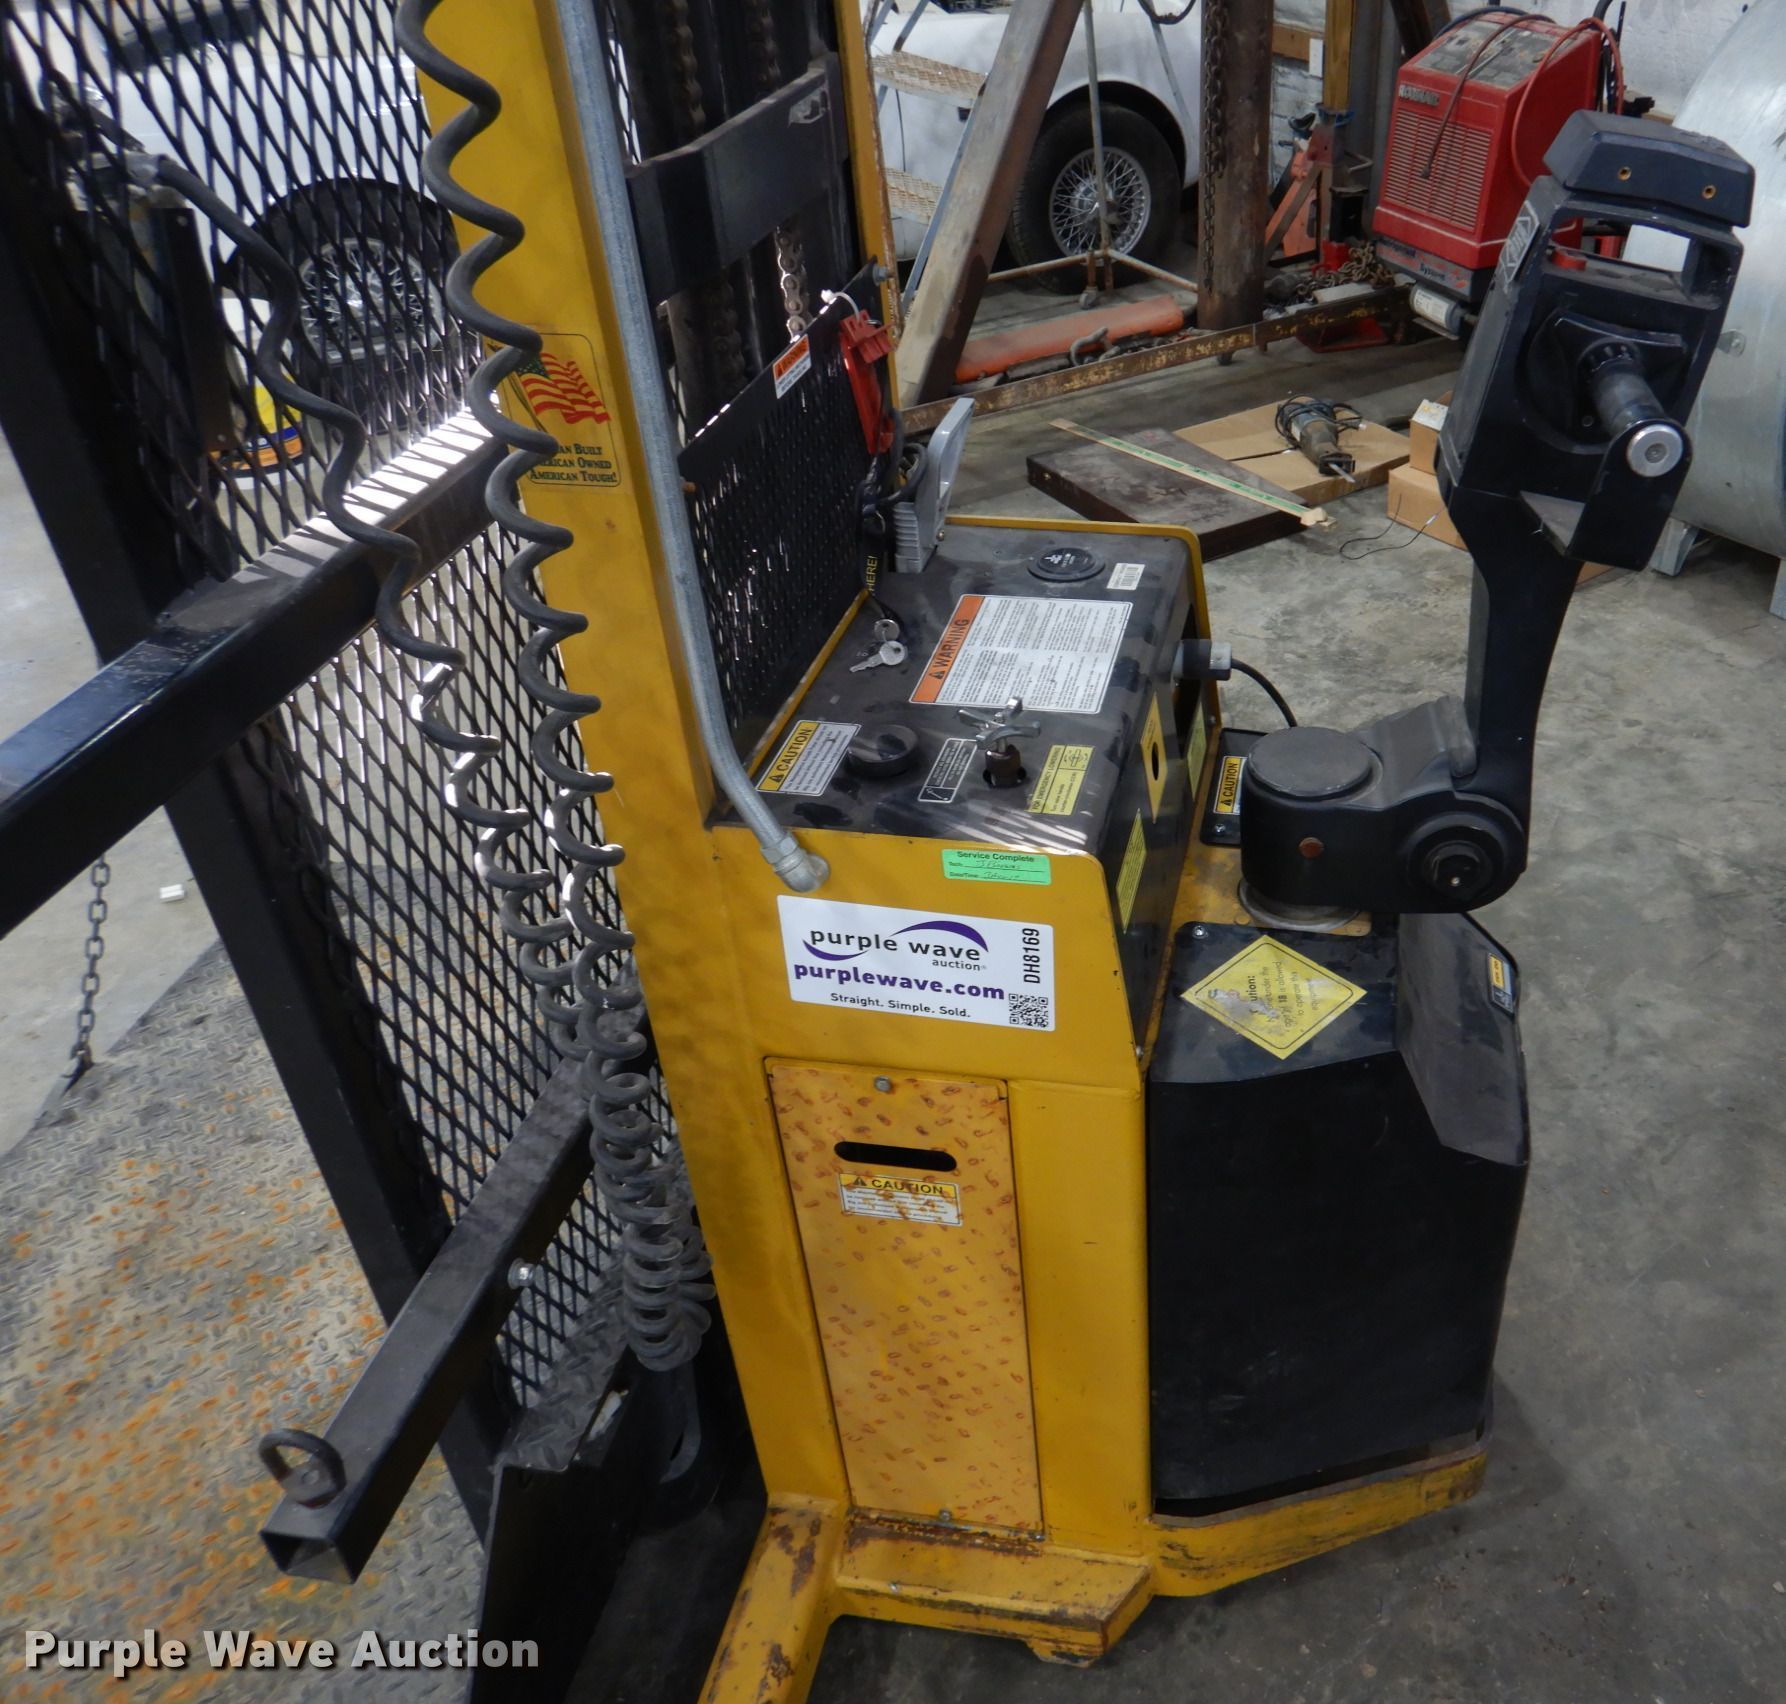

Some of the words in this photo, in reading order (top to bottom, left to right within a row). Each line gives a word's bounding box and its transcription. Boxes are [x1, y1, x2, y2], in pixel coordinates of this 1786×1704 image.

[933, 618, 970, 668] WARNING
[776, 728, 813, 772] CAUTION
[1222, 762, 1240, 798] CAUTION
[957, 851, 990, 860] Service
[992, 853, 1035, 862] Complete
[810, 930, 898, 951] purple
[908, 941, 981, 961] wave
[1022, 928, 1041, 984] DH8169
[794, 963, 1005, 1001] purplewave.com
[932, 959, 981, 971] auction
[830, 993, 884, 1008] Straight.
[888, 1000, 935, 1015] Simple.
[939, 1006, 971, 1018] Sold.
[1246, 975, 1258, 1013] Cution:
[871, 1178, 943, 1195] CAUTION
